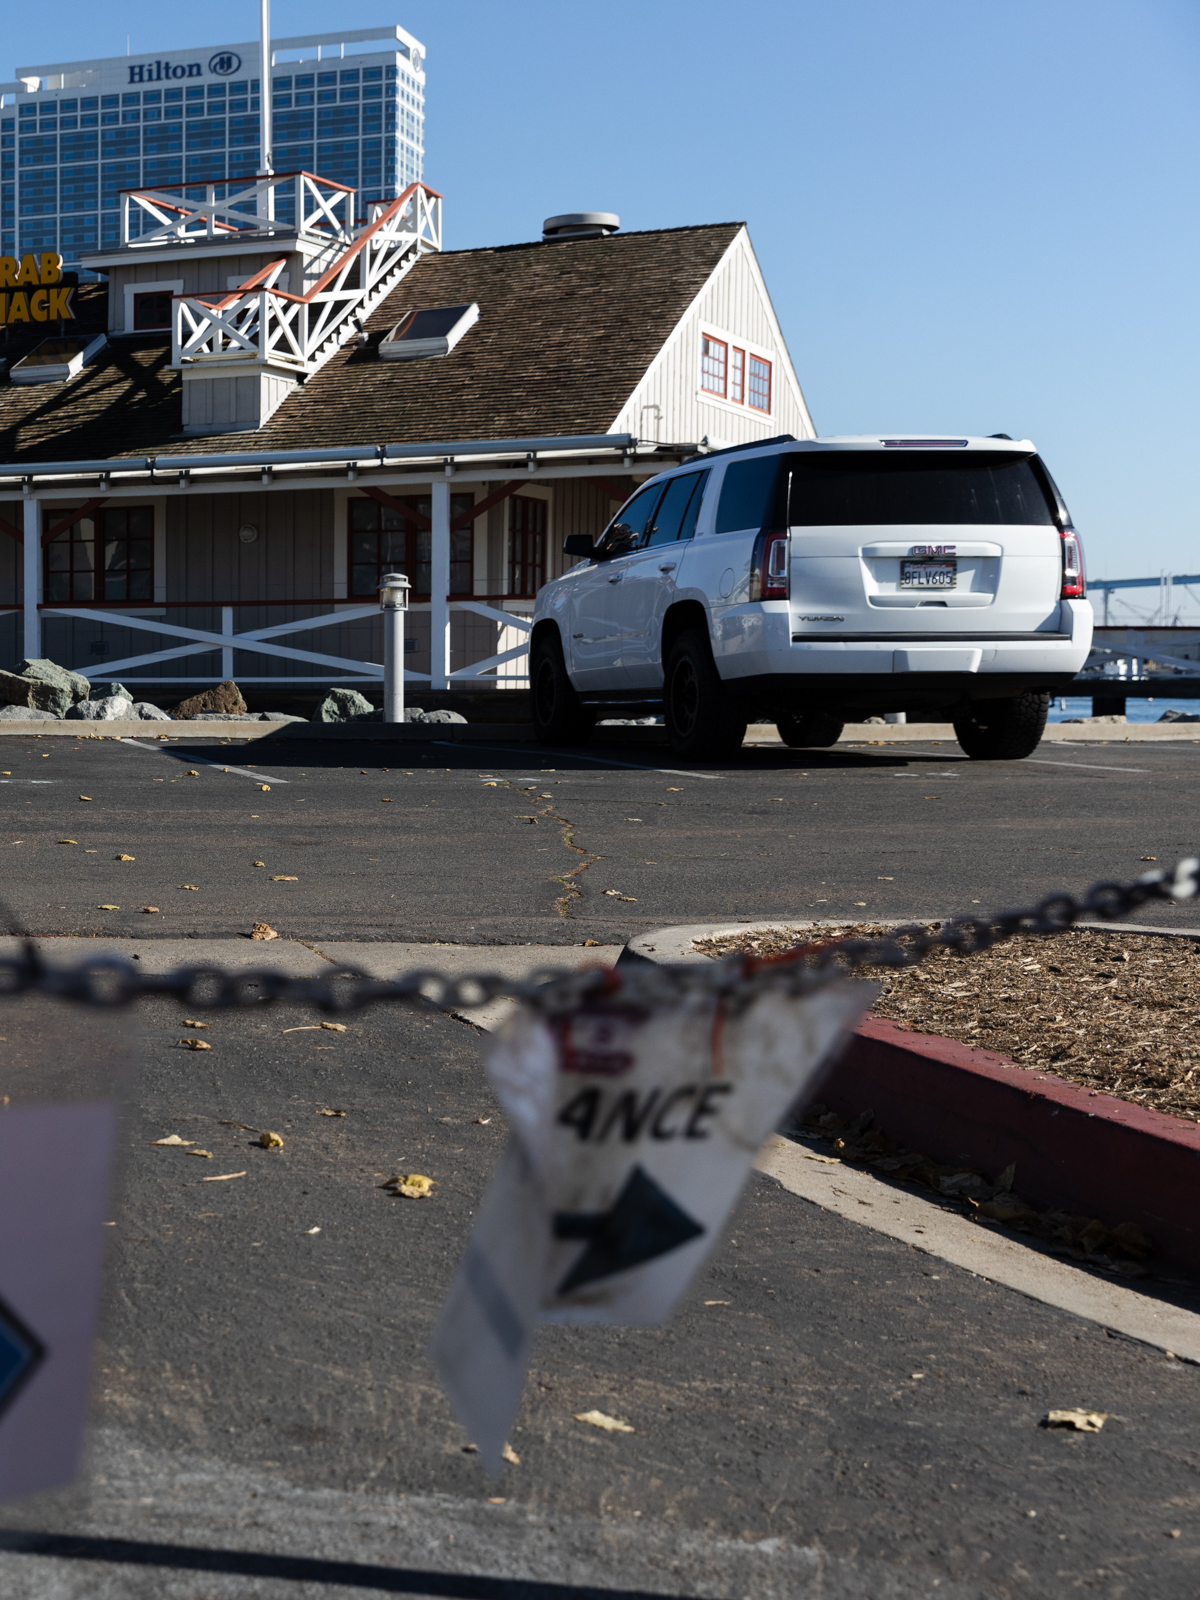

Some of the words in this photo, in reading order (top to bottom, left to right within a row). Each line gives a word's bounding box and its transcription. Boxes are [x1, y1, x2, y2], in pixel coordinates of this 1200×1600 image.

[128, 60, 202, 84] Hilton
[913, 545, 957, 555] GMC
[904, 571, 953, 585] 8FLV605
